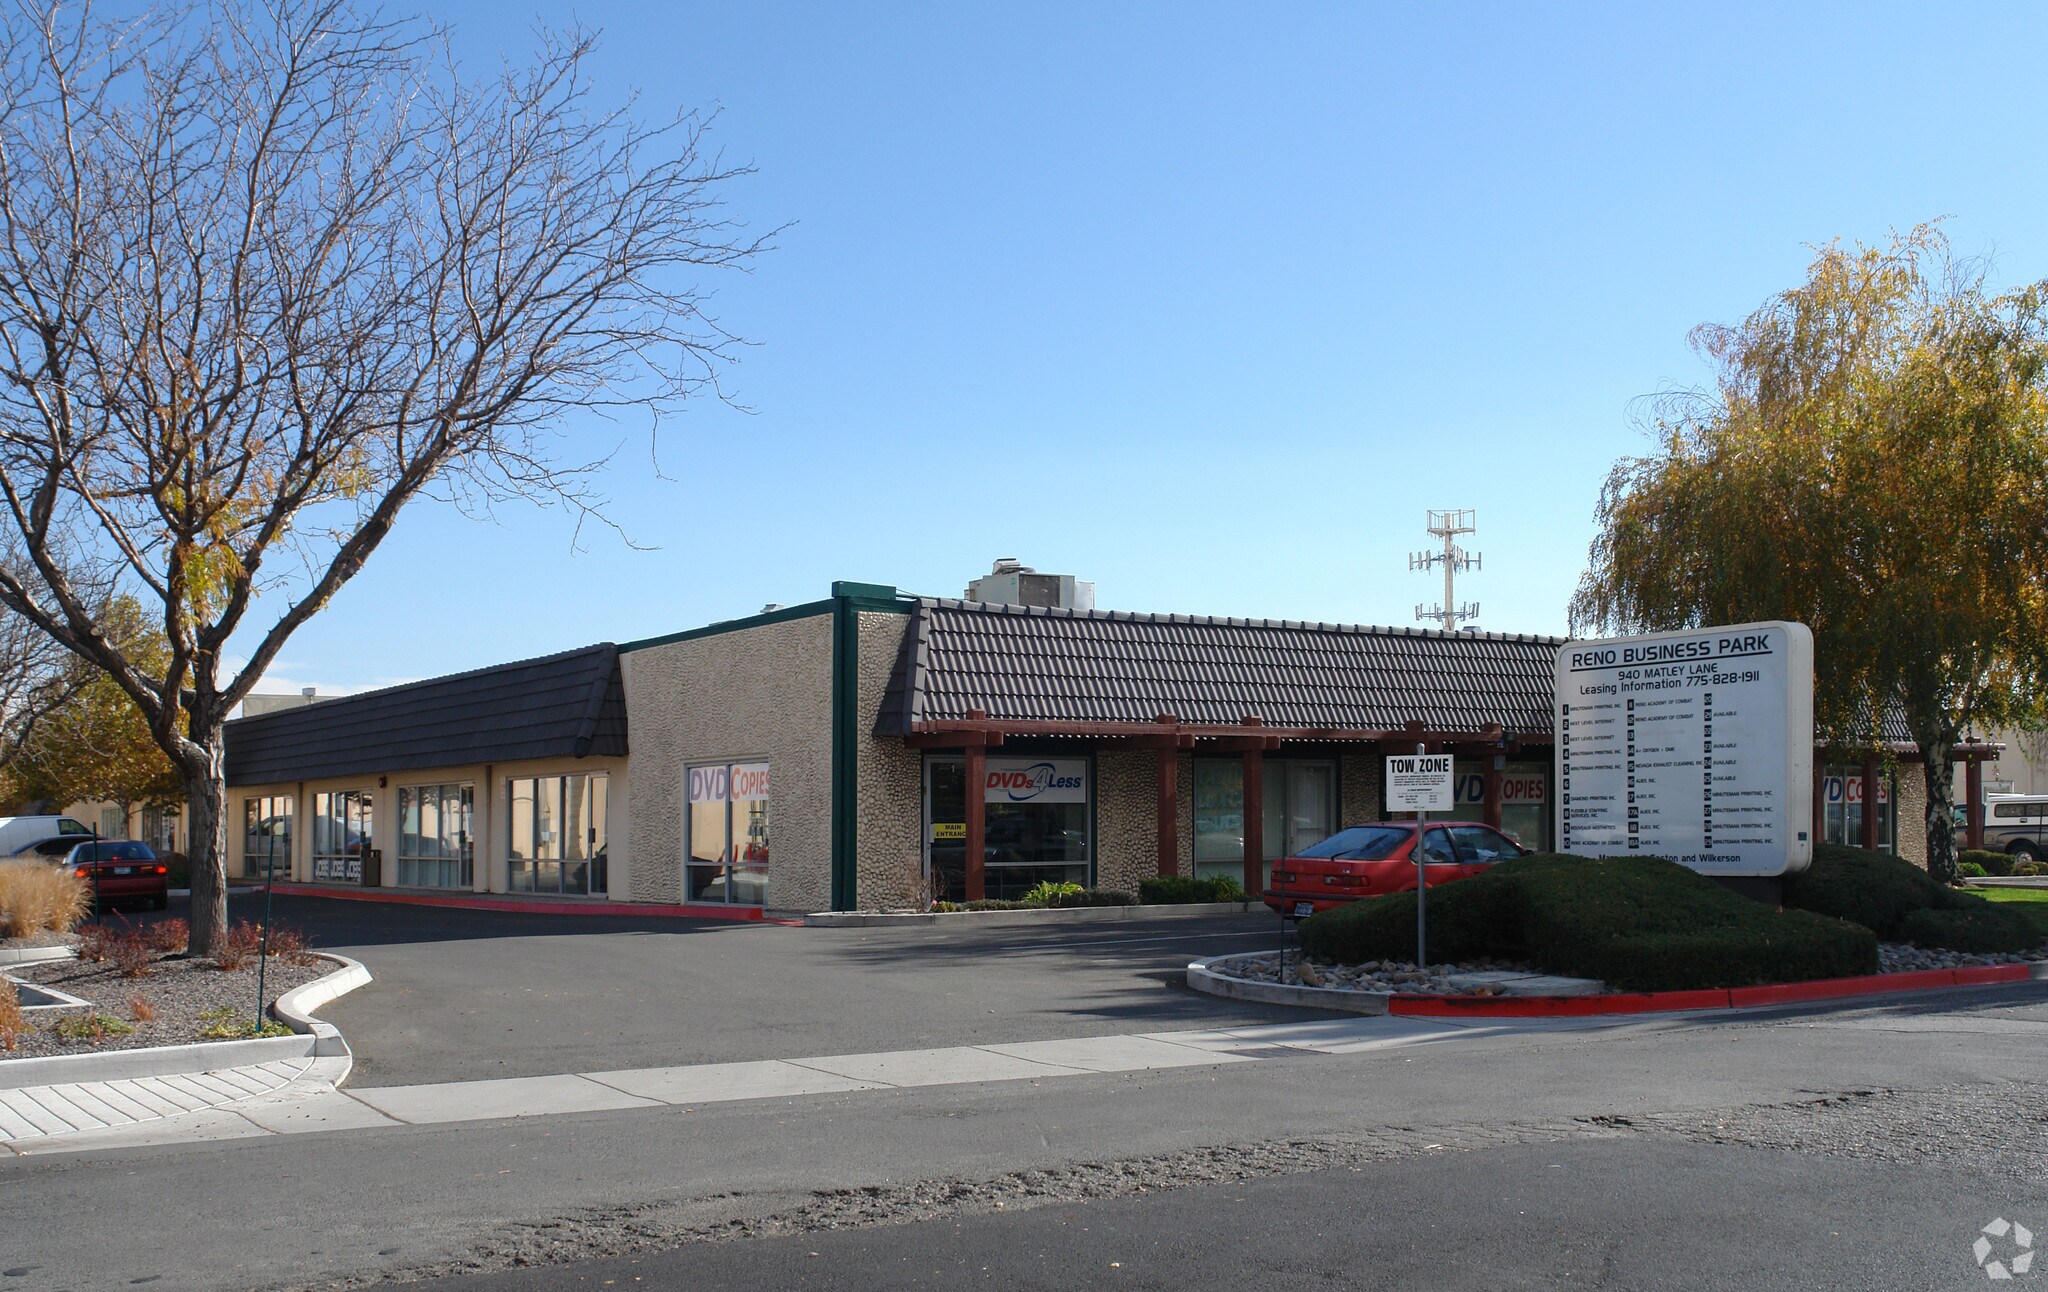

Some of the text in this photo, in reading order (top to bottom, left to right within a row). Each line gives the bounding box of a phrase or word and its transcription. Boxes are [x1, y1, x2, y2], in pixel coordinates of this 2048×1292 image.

[1572, 635, 1769, 667] RENO BUSINESS PARK
[1618, 662, 1718, 680] 940 MATLEY LANE
[1580, 671, 1760, 695] Leasing Information 775-828-1911
[1390, 759, 1449, 773] TOW ZONE
[691, 768, 726, 800] DVD
[986, 768, 1082, 792] DVDs4Less
[1500, 777, 1543, 800] OPIES
[1699, 854, 1740, 862] Wilkerson
